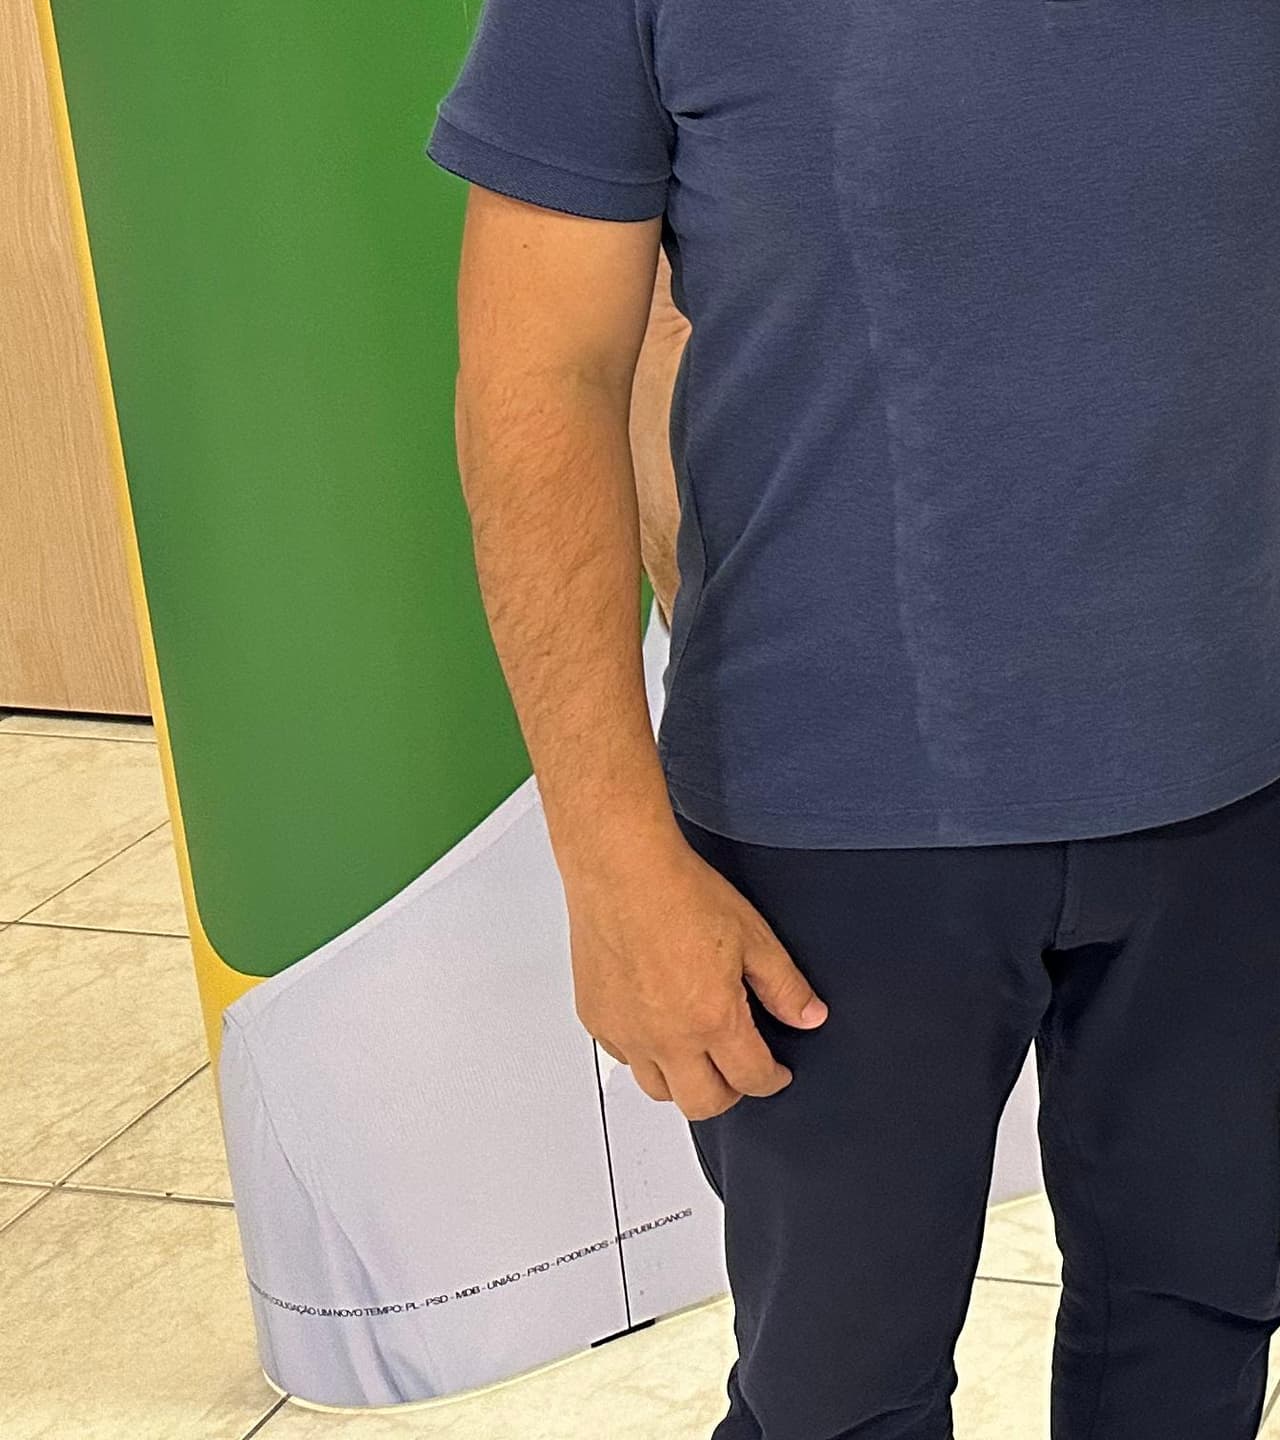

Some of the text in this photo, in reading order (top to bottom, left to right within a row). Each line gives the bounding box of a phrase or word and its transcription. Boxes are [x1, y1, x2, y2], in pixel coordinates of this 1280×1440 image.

[333, 1309, 363, 1318] NOVO
[405, 1302, 420, 1312] PL
[425, 1294, 449, 1307] PSD
[455, 1285, 481, 1300] MDB
[527, 1262, 550, 1277] PRD
[556, 1239, 609, 1267] PODEMOS
